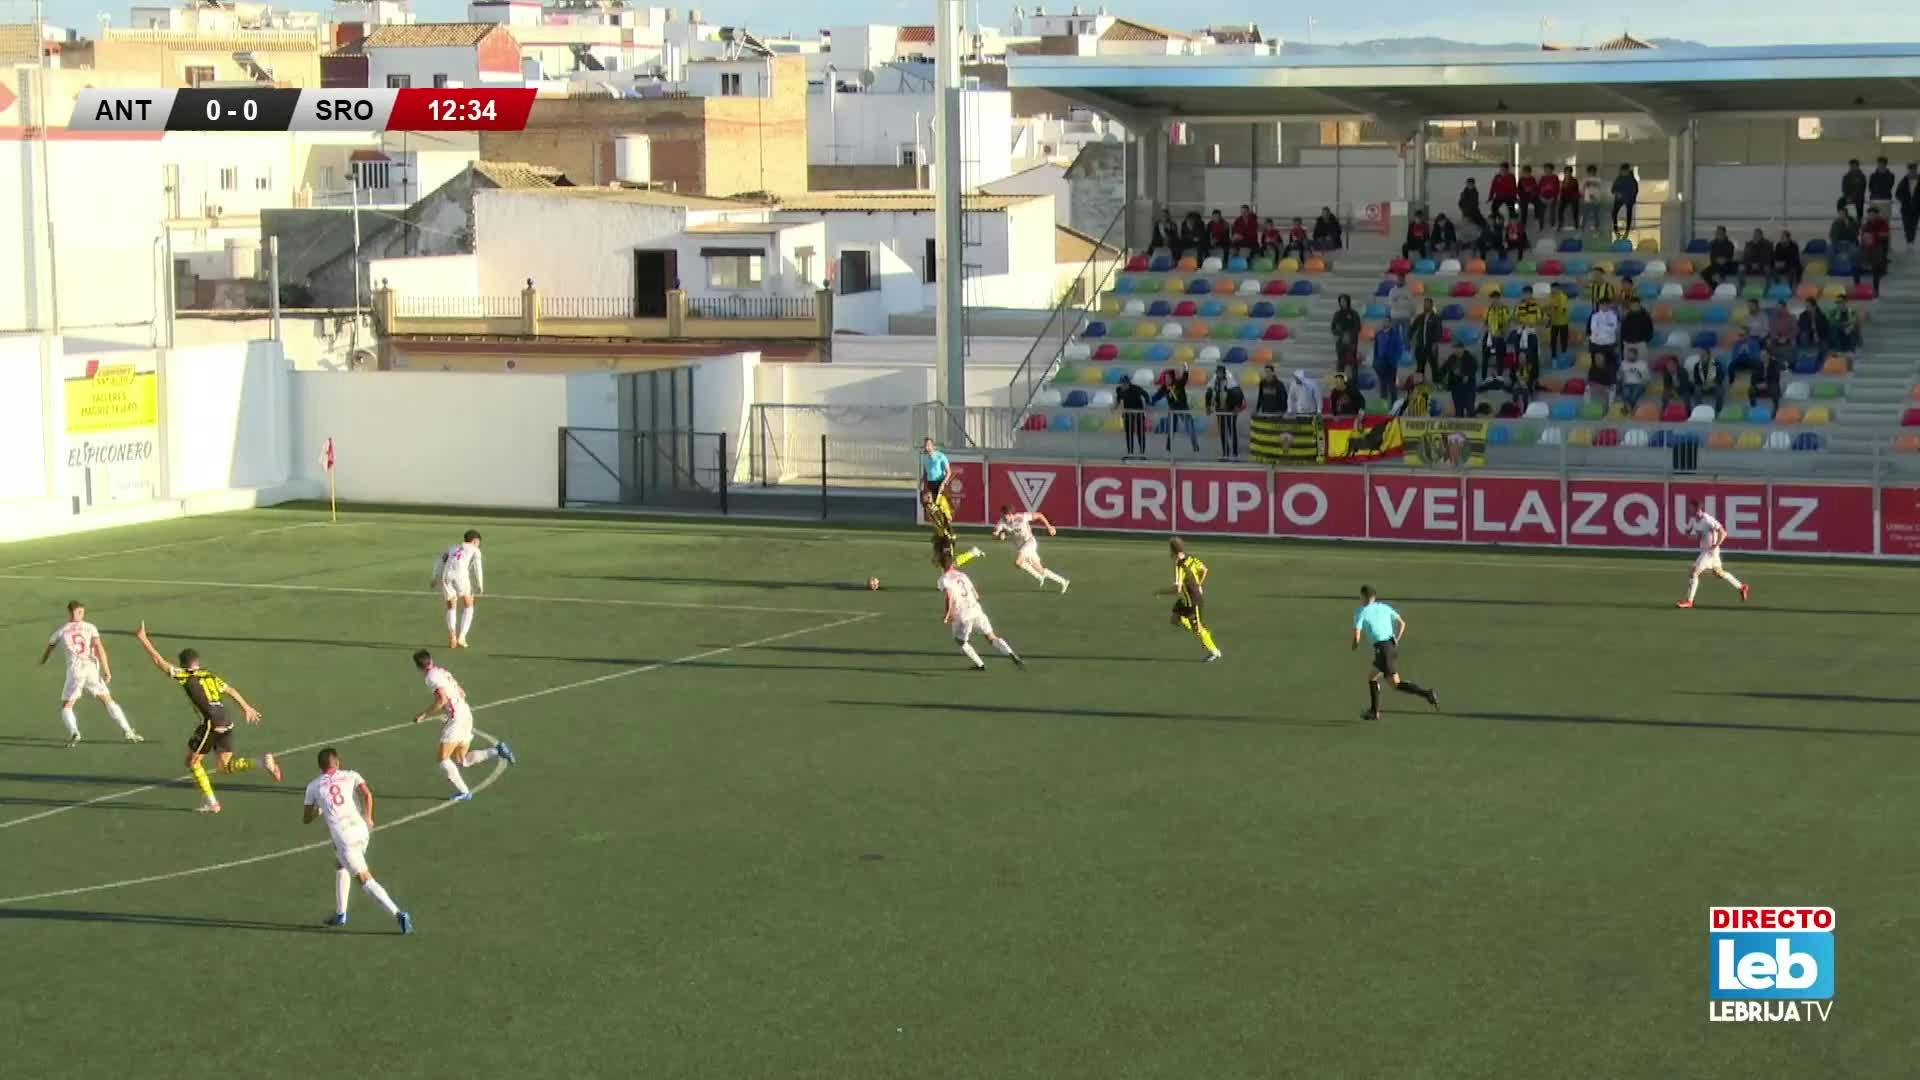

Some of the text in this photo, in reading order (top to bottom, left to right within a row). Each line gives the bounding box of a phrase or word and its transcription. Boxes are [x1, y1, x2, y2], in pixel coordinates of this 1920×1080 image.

[1084, 477, 1819, 542] GRUPO VELAZQUEZ
[71, 634, 86, 657] 5
[329, 784, 345, 807] 8
